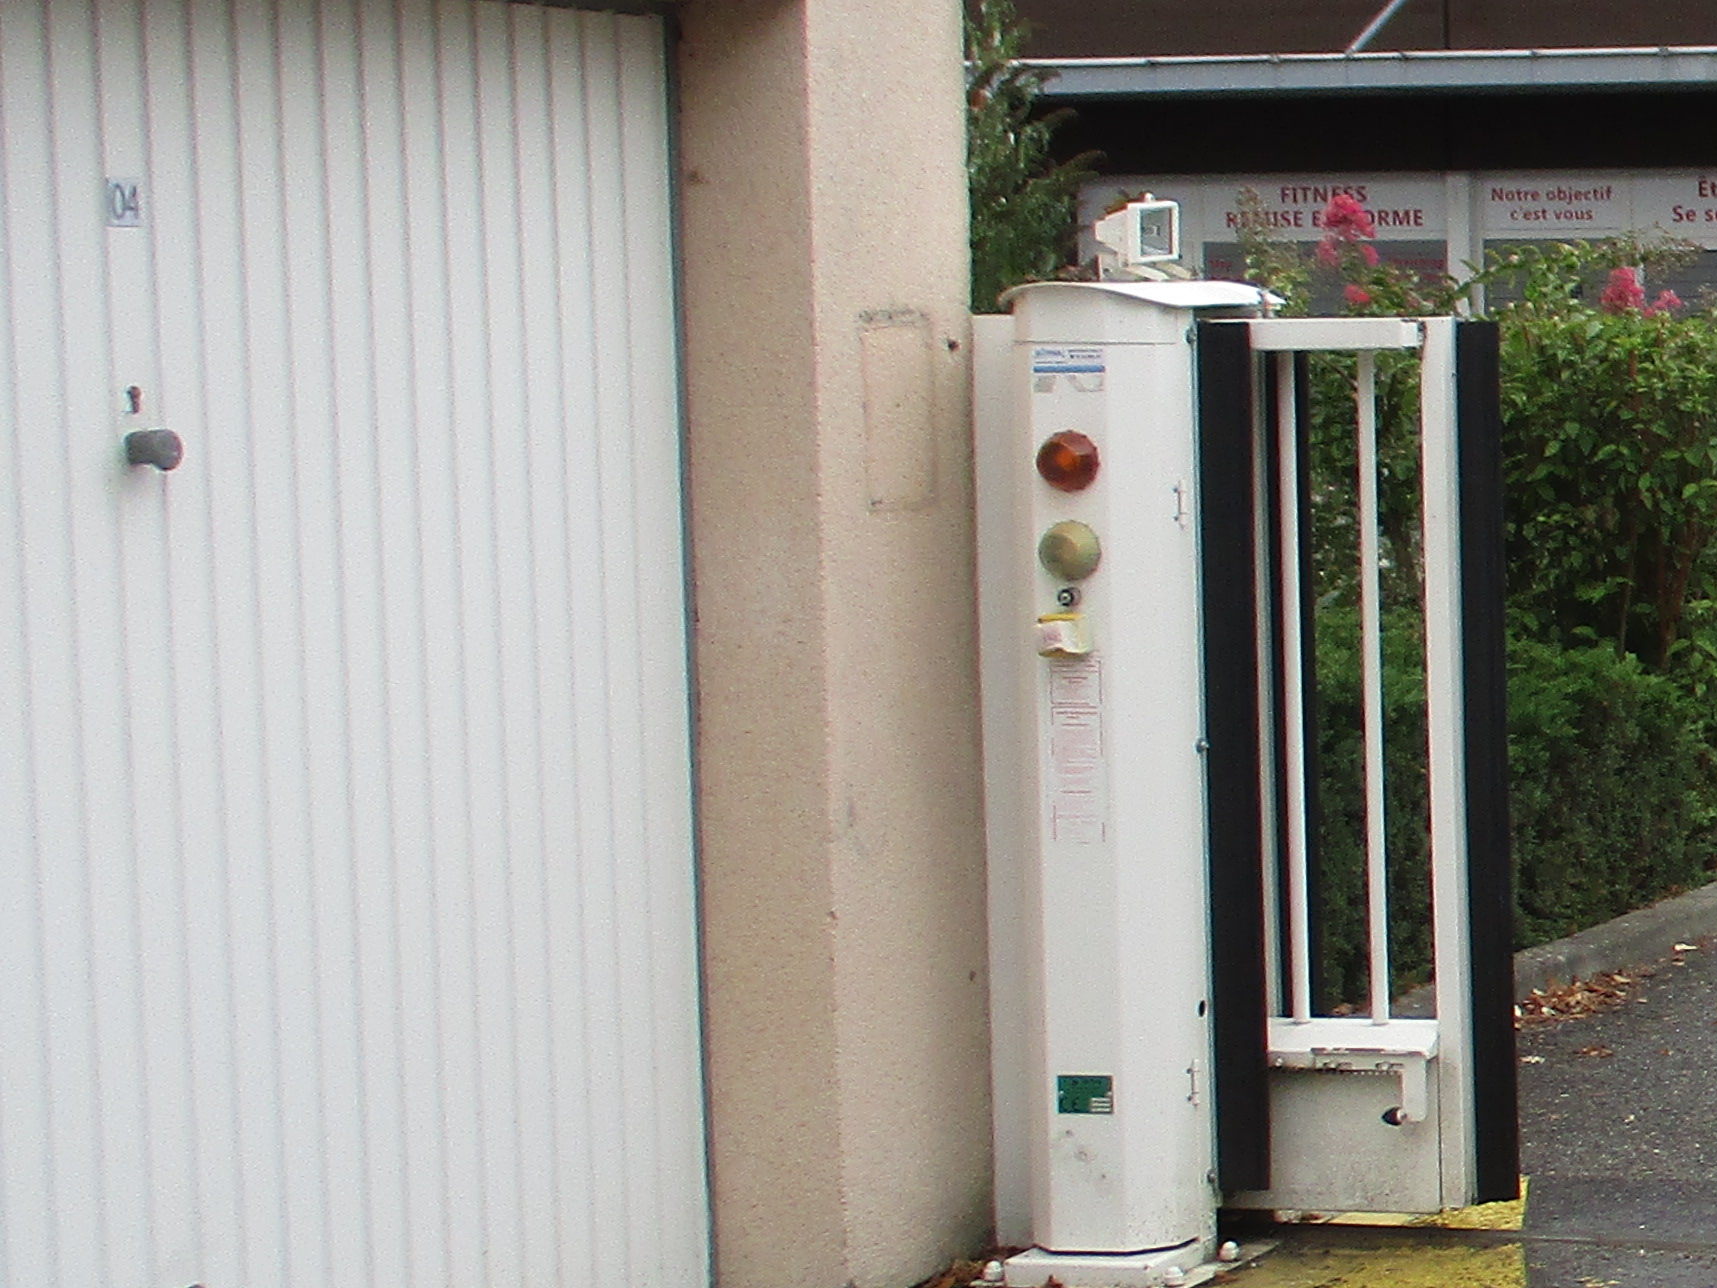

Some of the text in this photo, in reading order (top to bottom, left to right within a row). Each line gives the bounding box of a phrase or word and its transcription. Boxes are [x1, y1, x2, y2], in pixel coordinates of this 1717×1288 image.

[1491, 186, 1613, 204] Notre objectif
[1226, 210, 1302, 228] RISE
[1362, 210, 1424, 227] ORME
[1554, 210, 1594, 221] vous
[1672, 205, 1697, 223] Se
